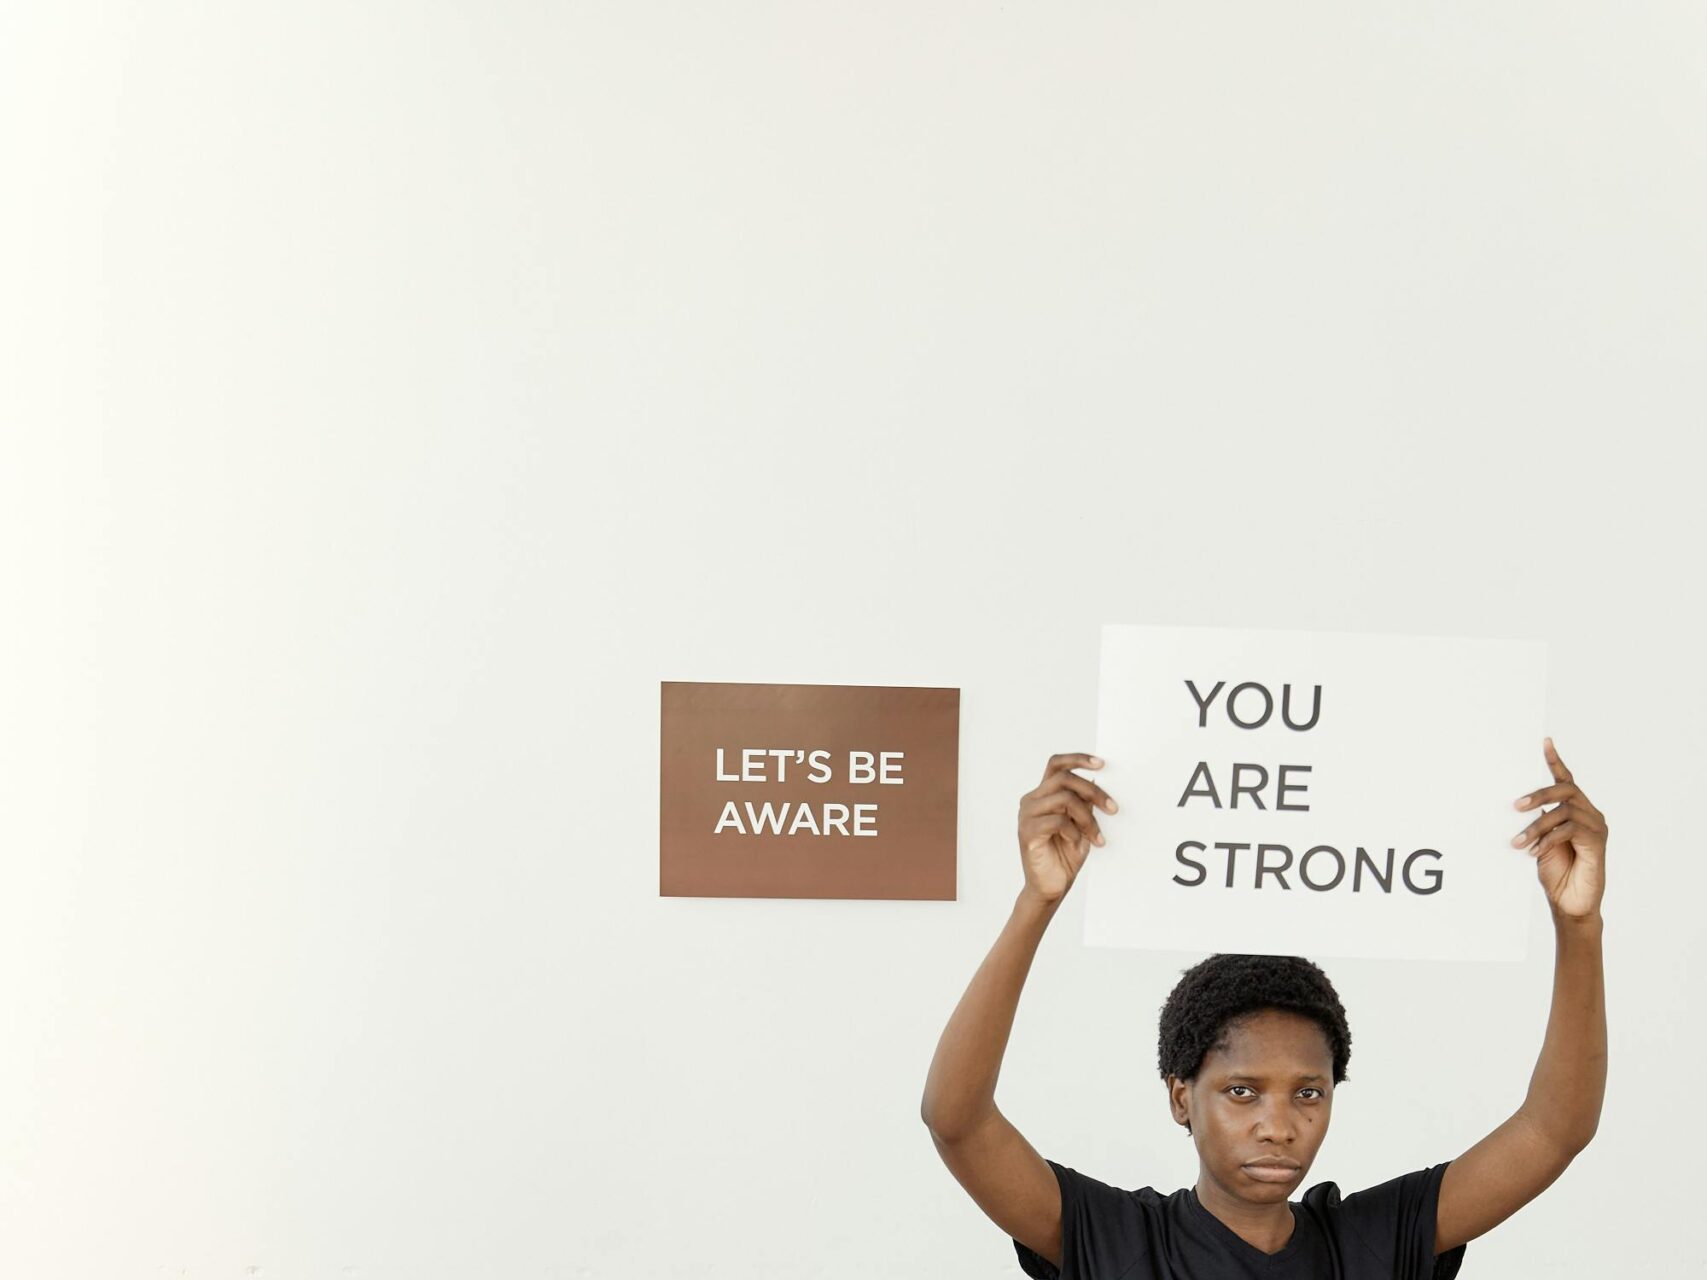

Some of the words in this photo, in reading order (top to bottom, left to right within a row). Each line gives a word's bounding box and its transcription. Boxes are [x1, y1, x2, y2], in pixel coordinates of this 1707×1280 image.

[1184, 680, 1323, 732] YOU
[848, 750, 905, 785] BE
[1177, 761, 1313, 812] ARE
[713, 800, 879, 837] AWARE
[1171, 840, 1445, 896] STRONG
